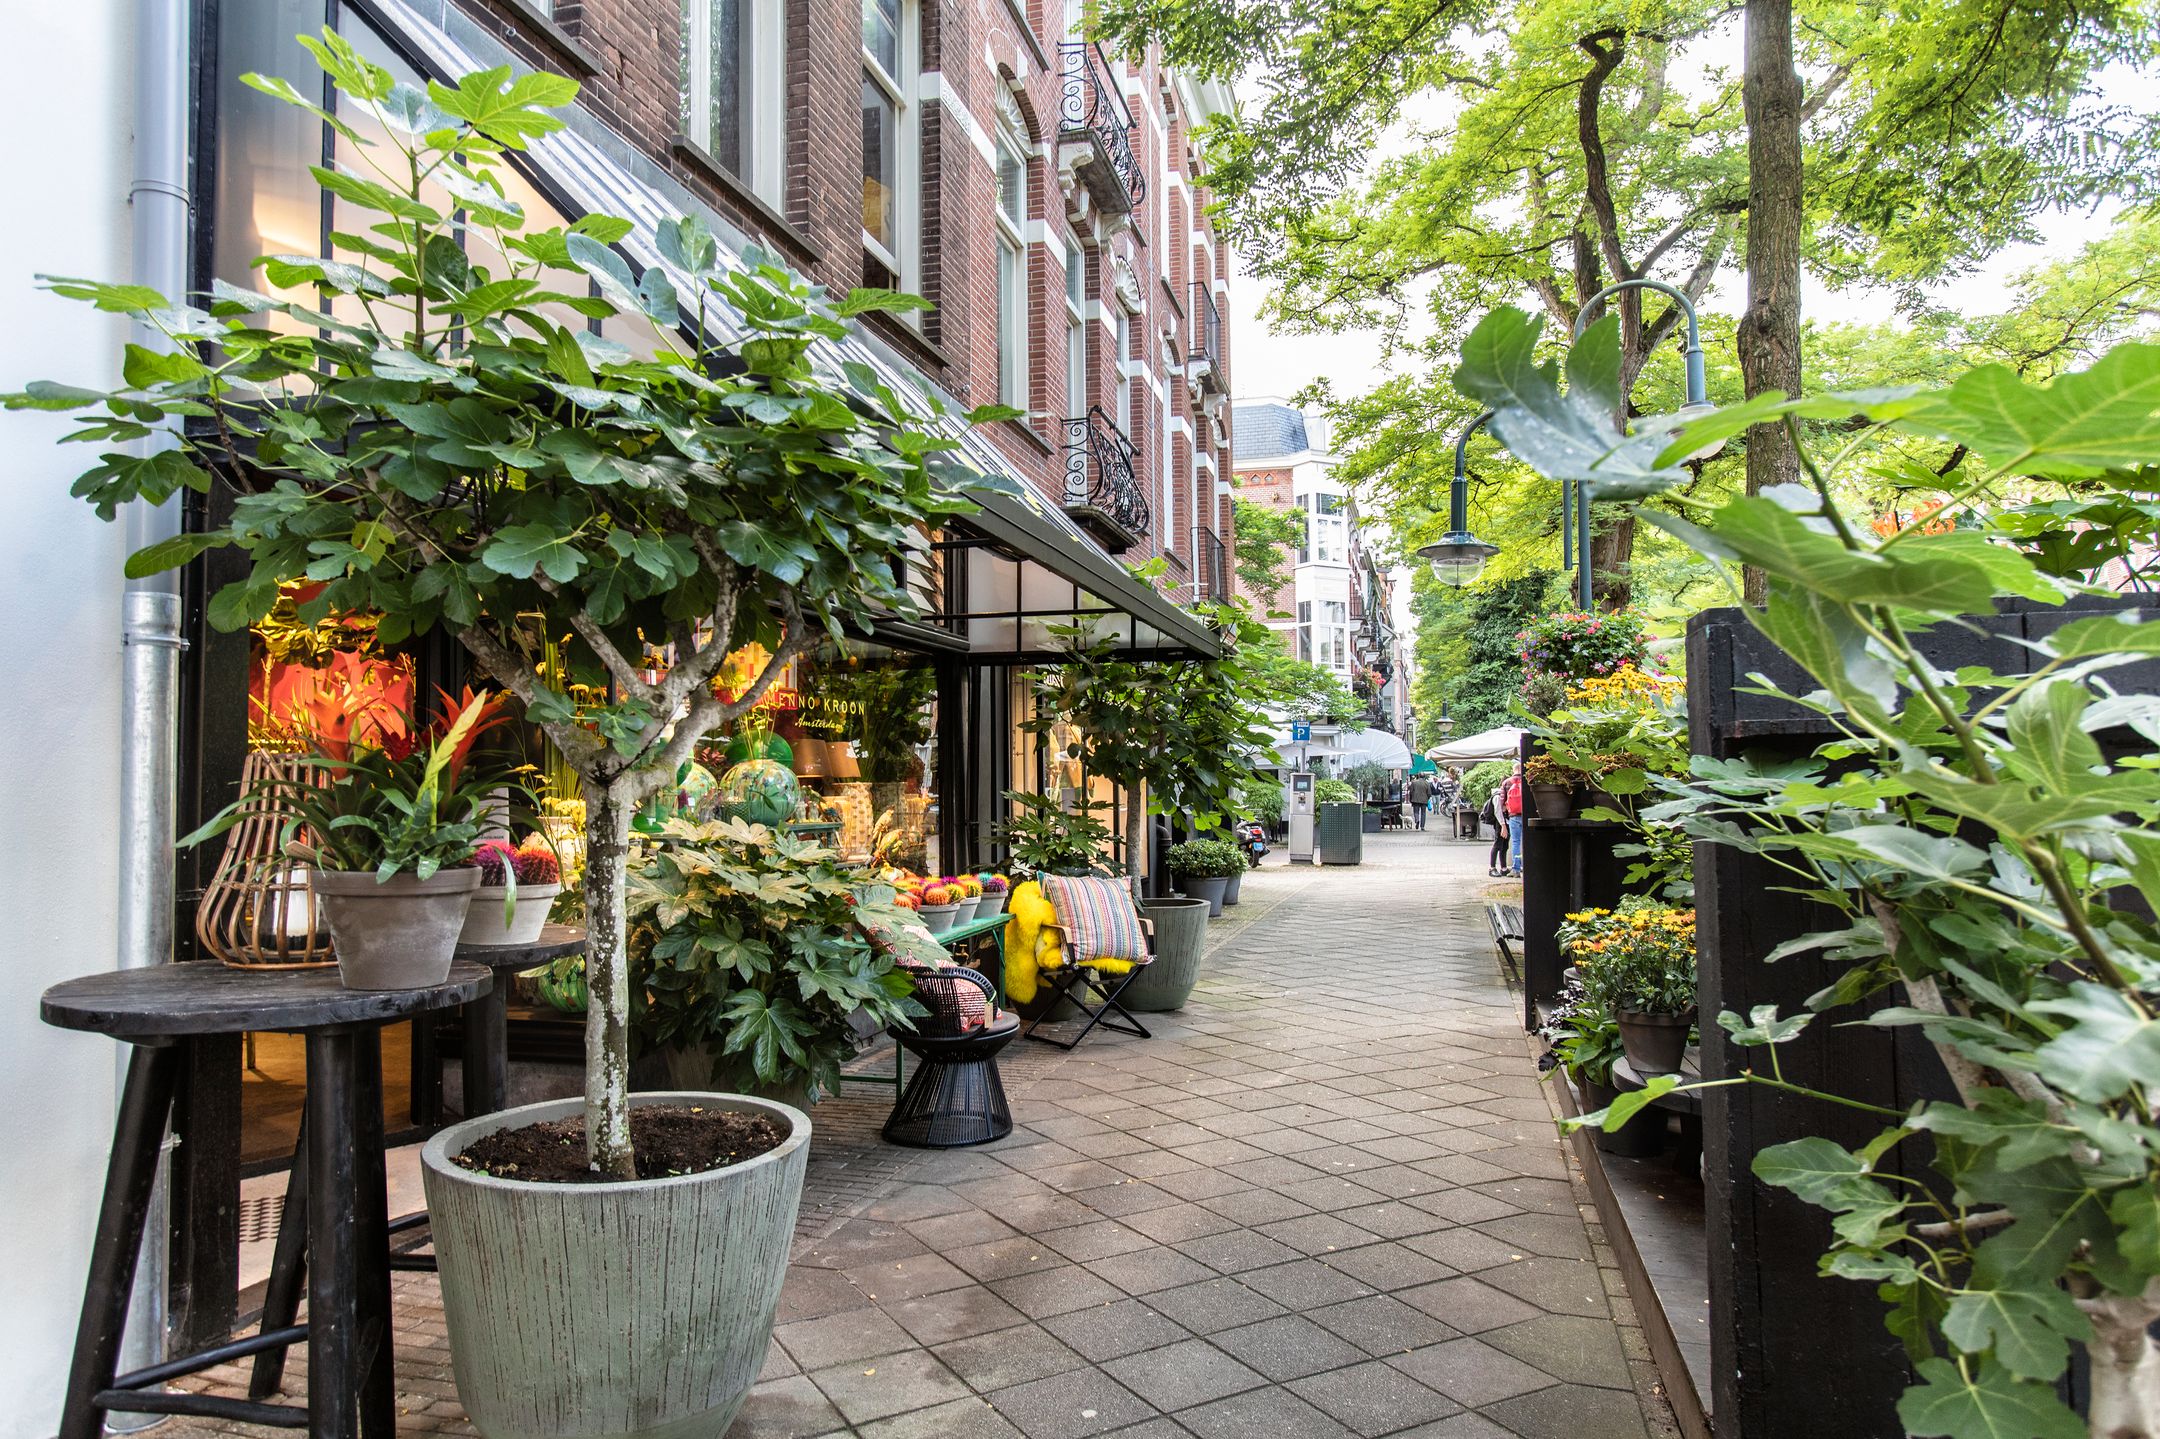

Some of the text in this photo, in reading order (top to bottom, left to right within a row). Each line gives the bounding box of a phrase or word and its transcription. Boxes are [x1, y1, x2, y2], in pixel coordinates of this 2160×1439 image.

[824, 698, 865, 715] KROON
[795, 712, 844, 730] Amsterdam
[1297, 728, 1305, 739] P
